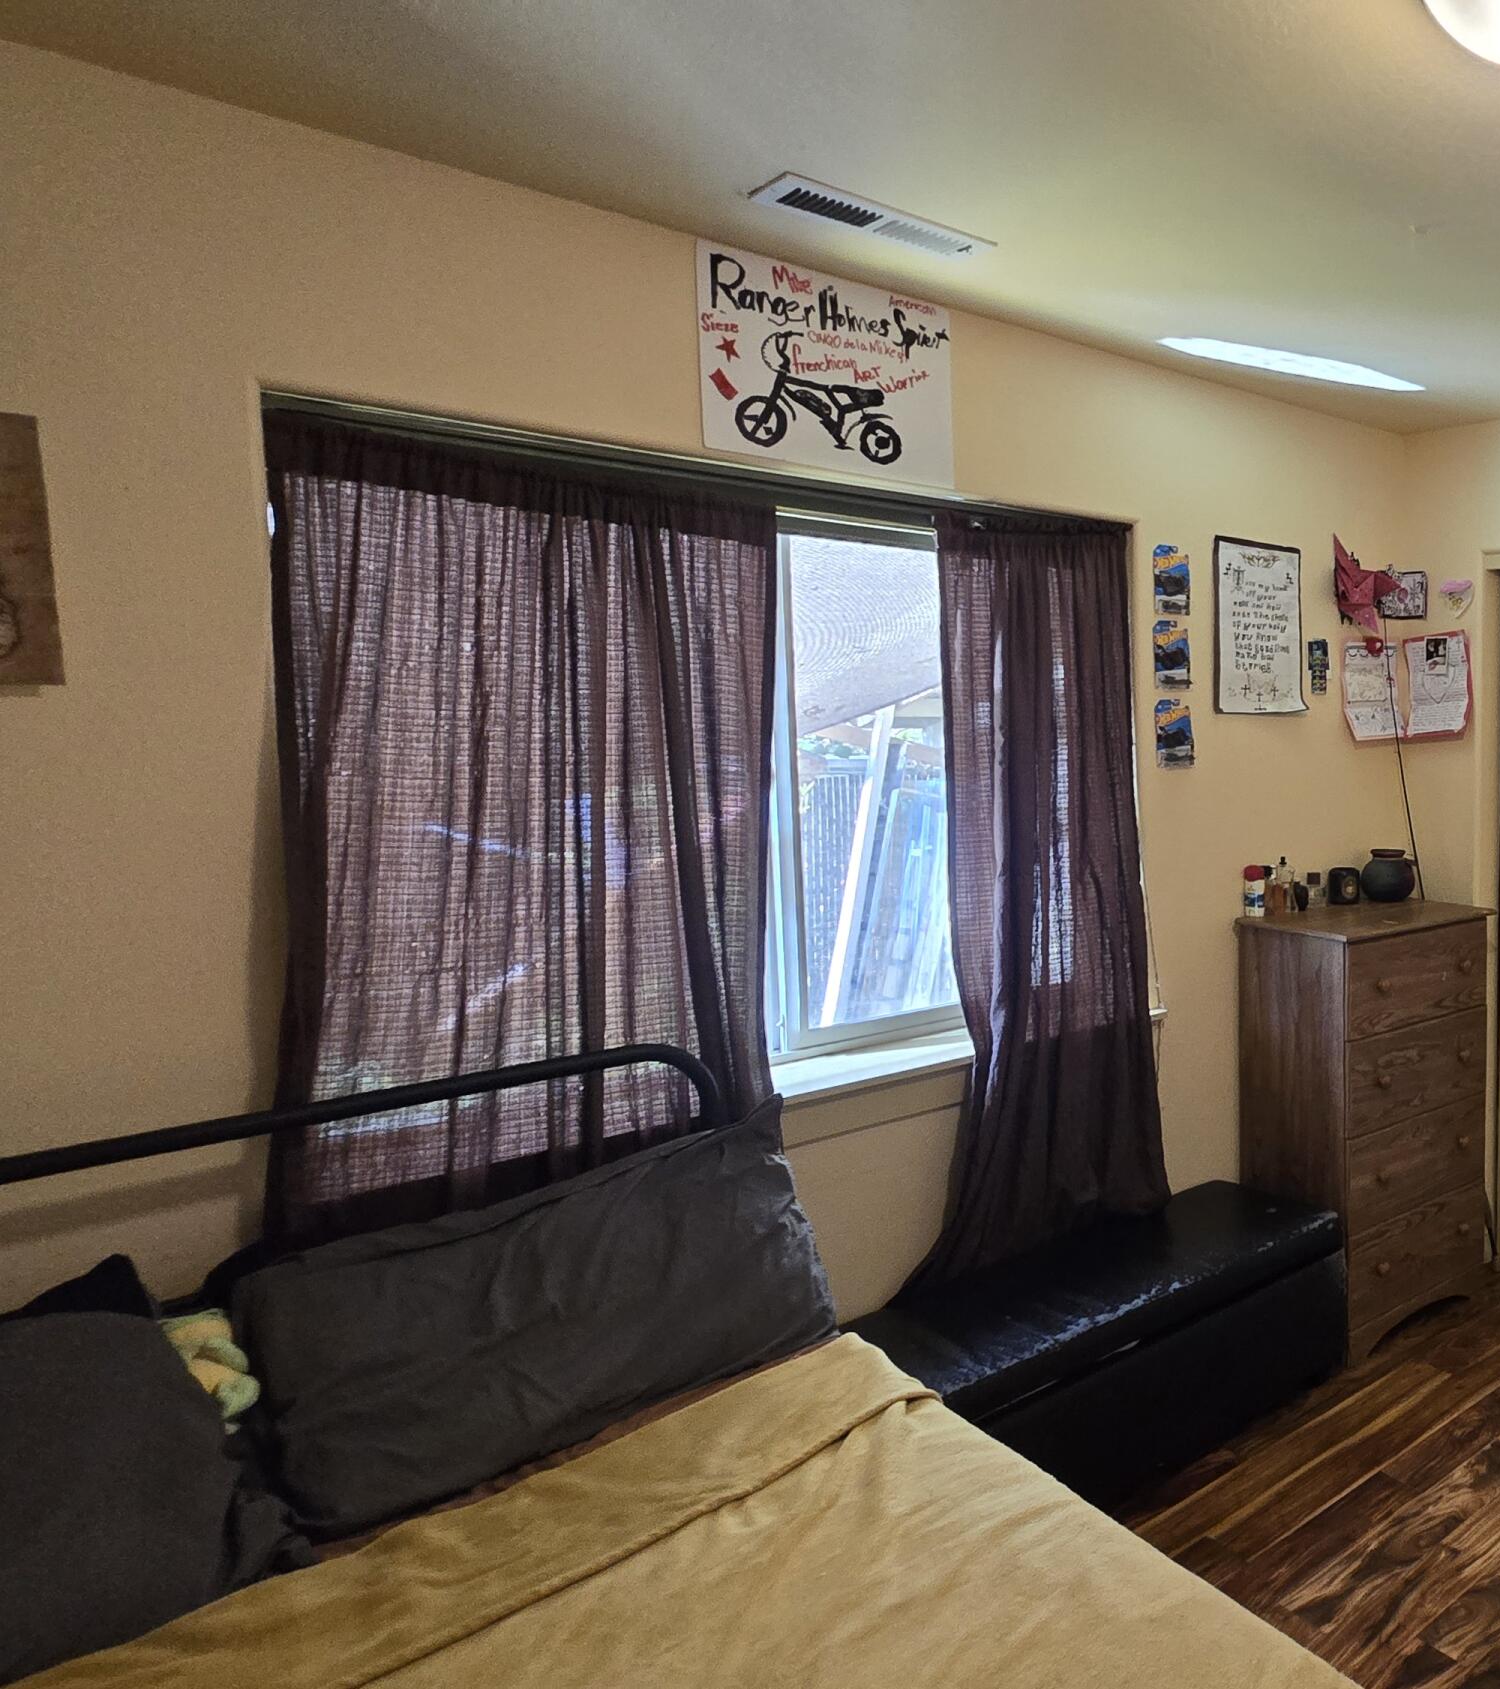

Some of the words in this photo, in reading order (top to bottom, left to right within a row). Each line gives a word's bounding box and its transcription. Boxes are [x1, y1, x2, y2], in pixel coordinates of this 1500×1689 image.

[709, 252, 816, 328] Ranger
[818, 285, 891, 338] Holmes
[853, 366, 881, 384] ART
